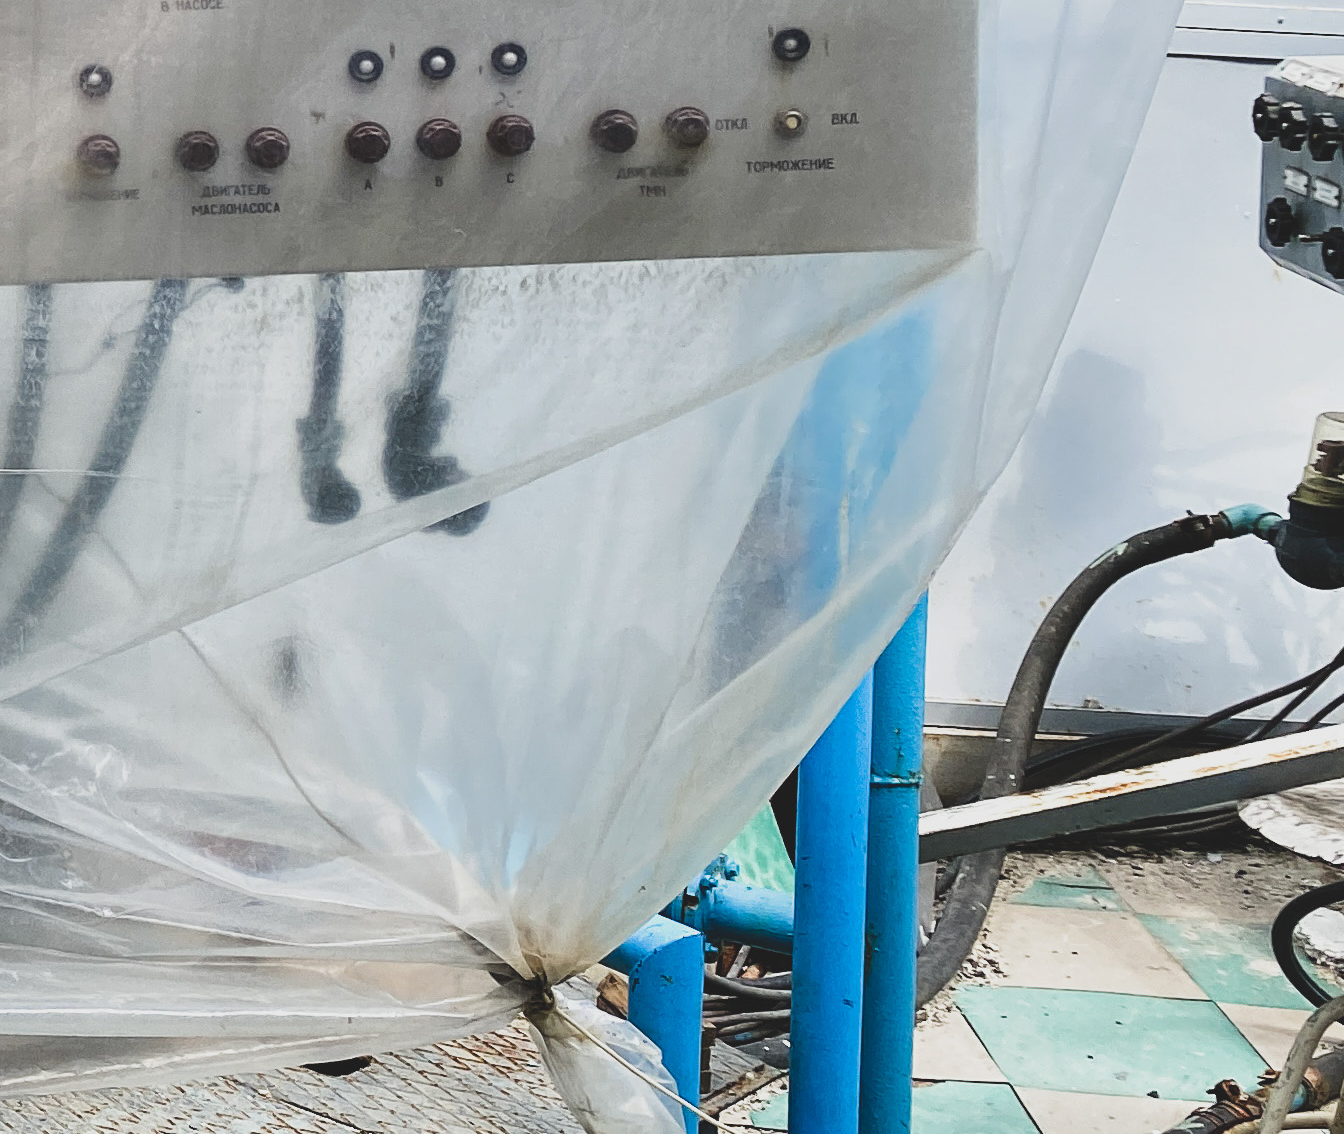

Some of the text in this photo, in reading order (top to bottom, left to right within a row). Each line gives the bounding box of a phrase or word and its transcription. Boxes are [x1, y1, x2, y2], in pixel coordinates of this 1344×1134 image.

[746, 157, 835, 174] ТОРМОЖЕНИЕ
[200, 184, 271, 198] ДВИГАТЕЛЬ
[192, 202, 281, 216] МАСЛОНАСОСА
